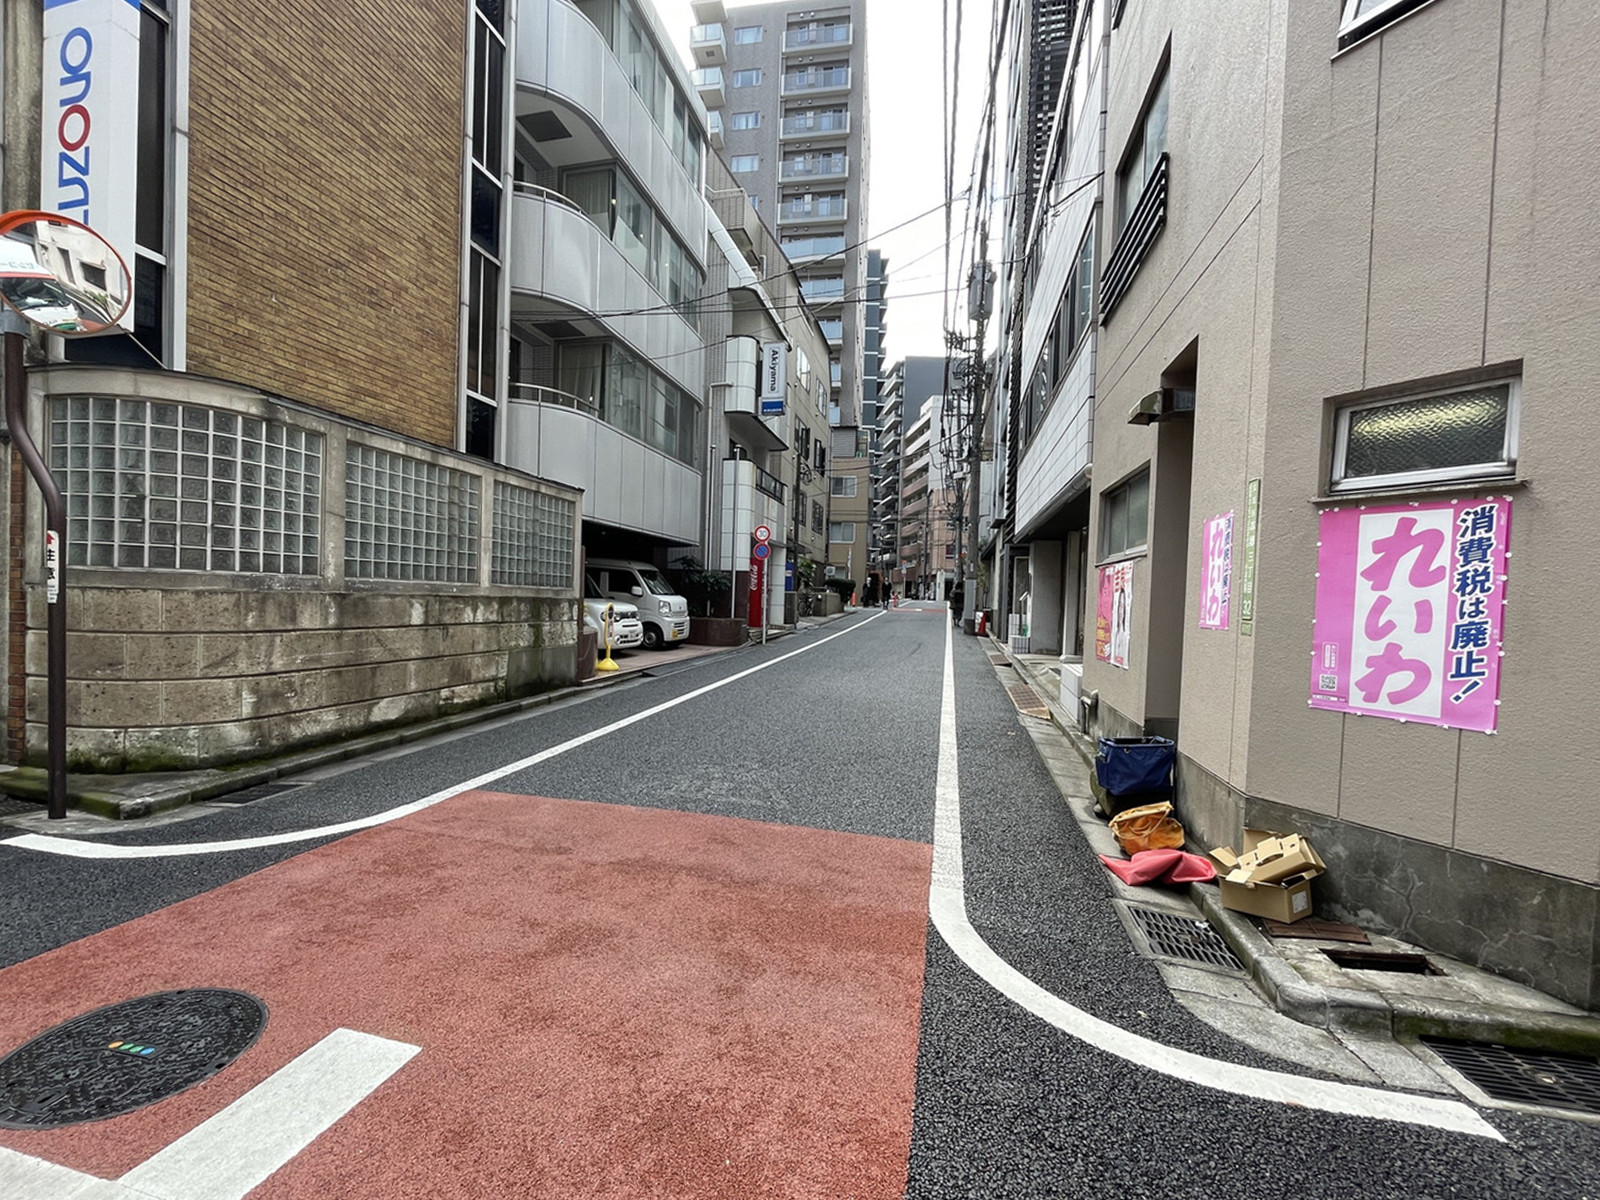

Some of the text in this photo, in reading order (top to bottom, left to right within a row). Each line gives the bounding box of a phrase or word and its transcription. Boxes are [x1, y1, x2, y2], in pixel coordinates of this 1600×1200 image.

[769, 349, 779, 392] Akiyama
[758, 530, 767, 538] 30
[1207, 522, 1224, 621] れいわ
[1242, 600, 1252, 615] 32
[1355, 516, 1446, 705] れいわ
